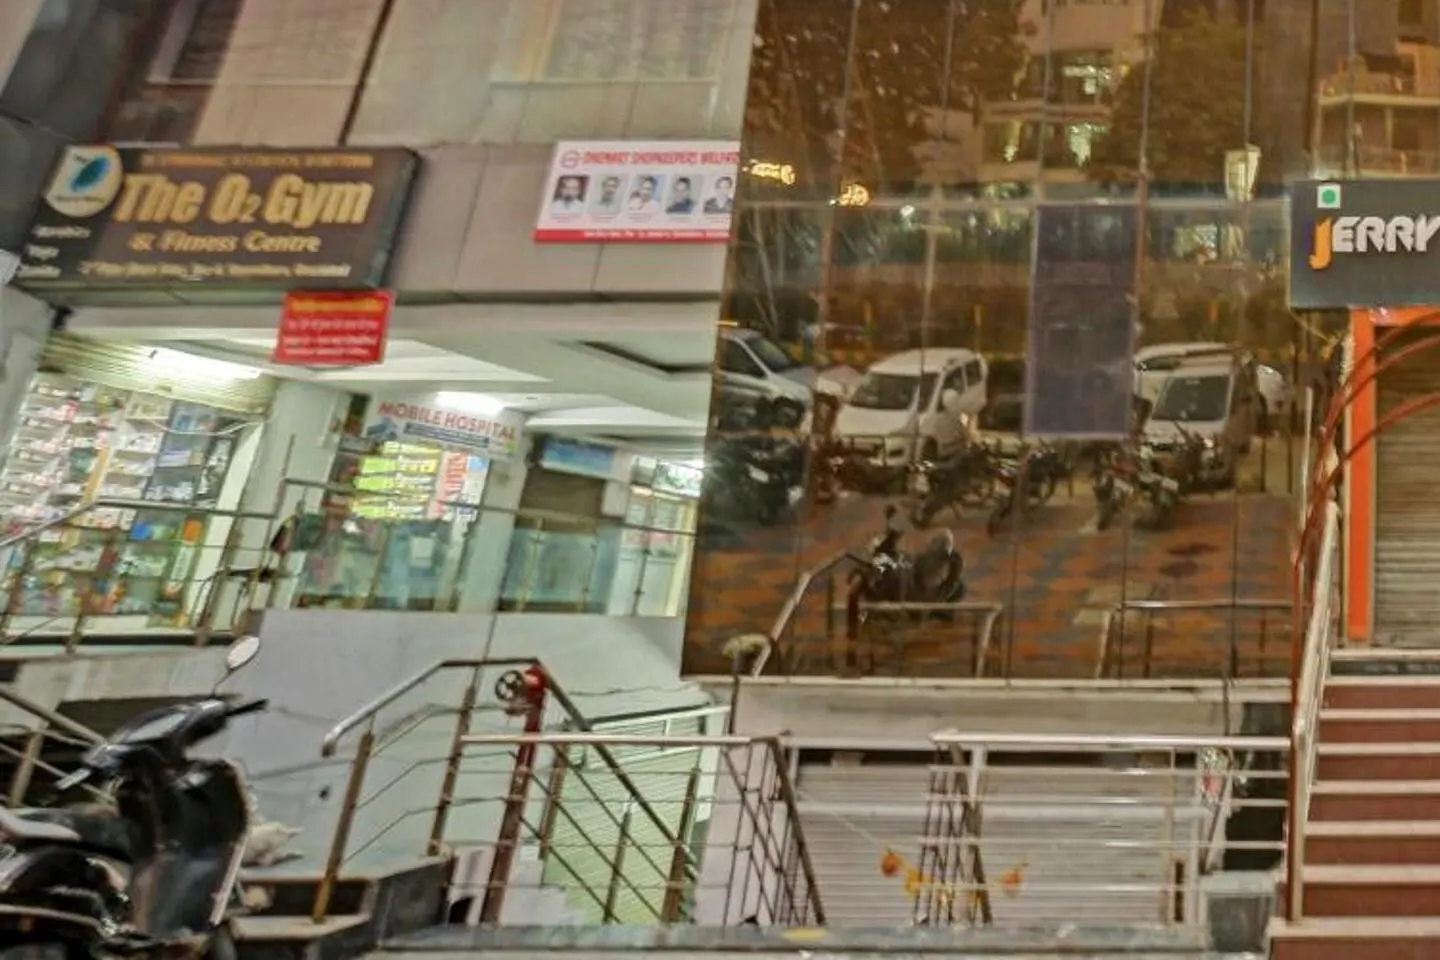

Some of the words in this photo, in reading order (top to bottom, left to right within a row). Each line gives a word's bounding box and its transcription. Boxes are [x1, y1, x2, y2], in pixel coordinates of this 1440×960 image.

[113, 173, 206, 223] The
[264, 173, 374, 229] Gym
[128, 232, 156, 251] &
[159, 229, 239, 252] Fitness
[242, 230, 322, 253] Centre
[379, 401, 442, 426] MOBILE
[444, 410, 517, 440] HOSPITAL
